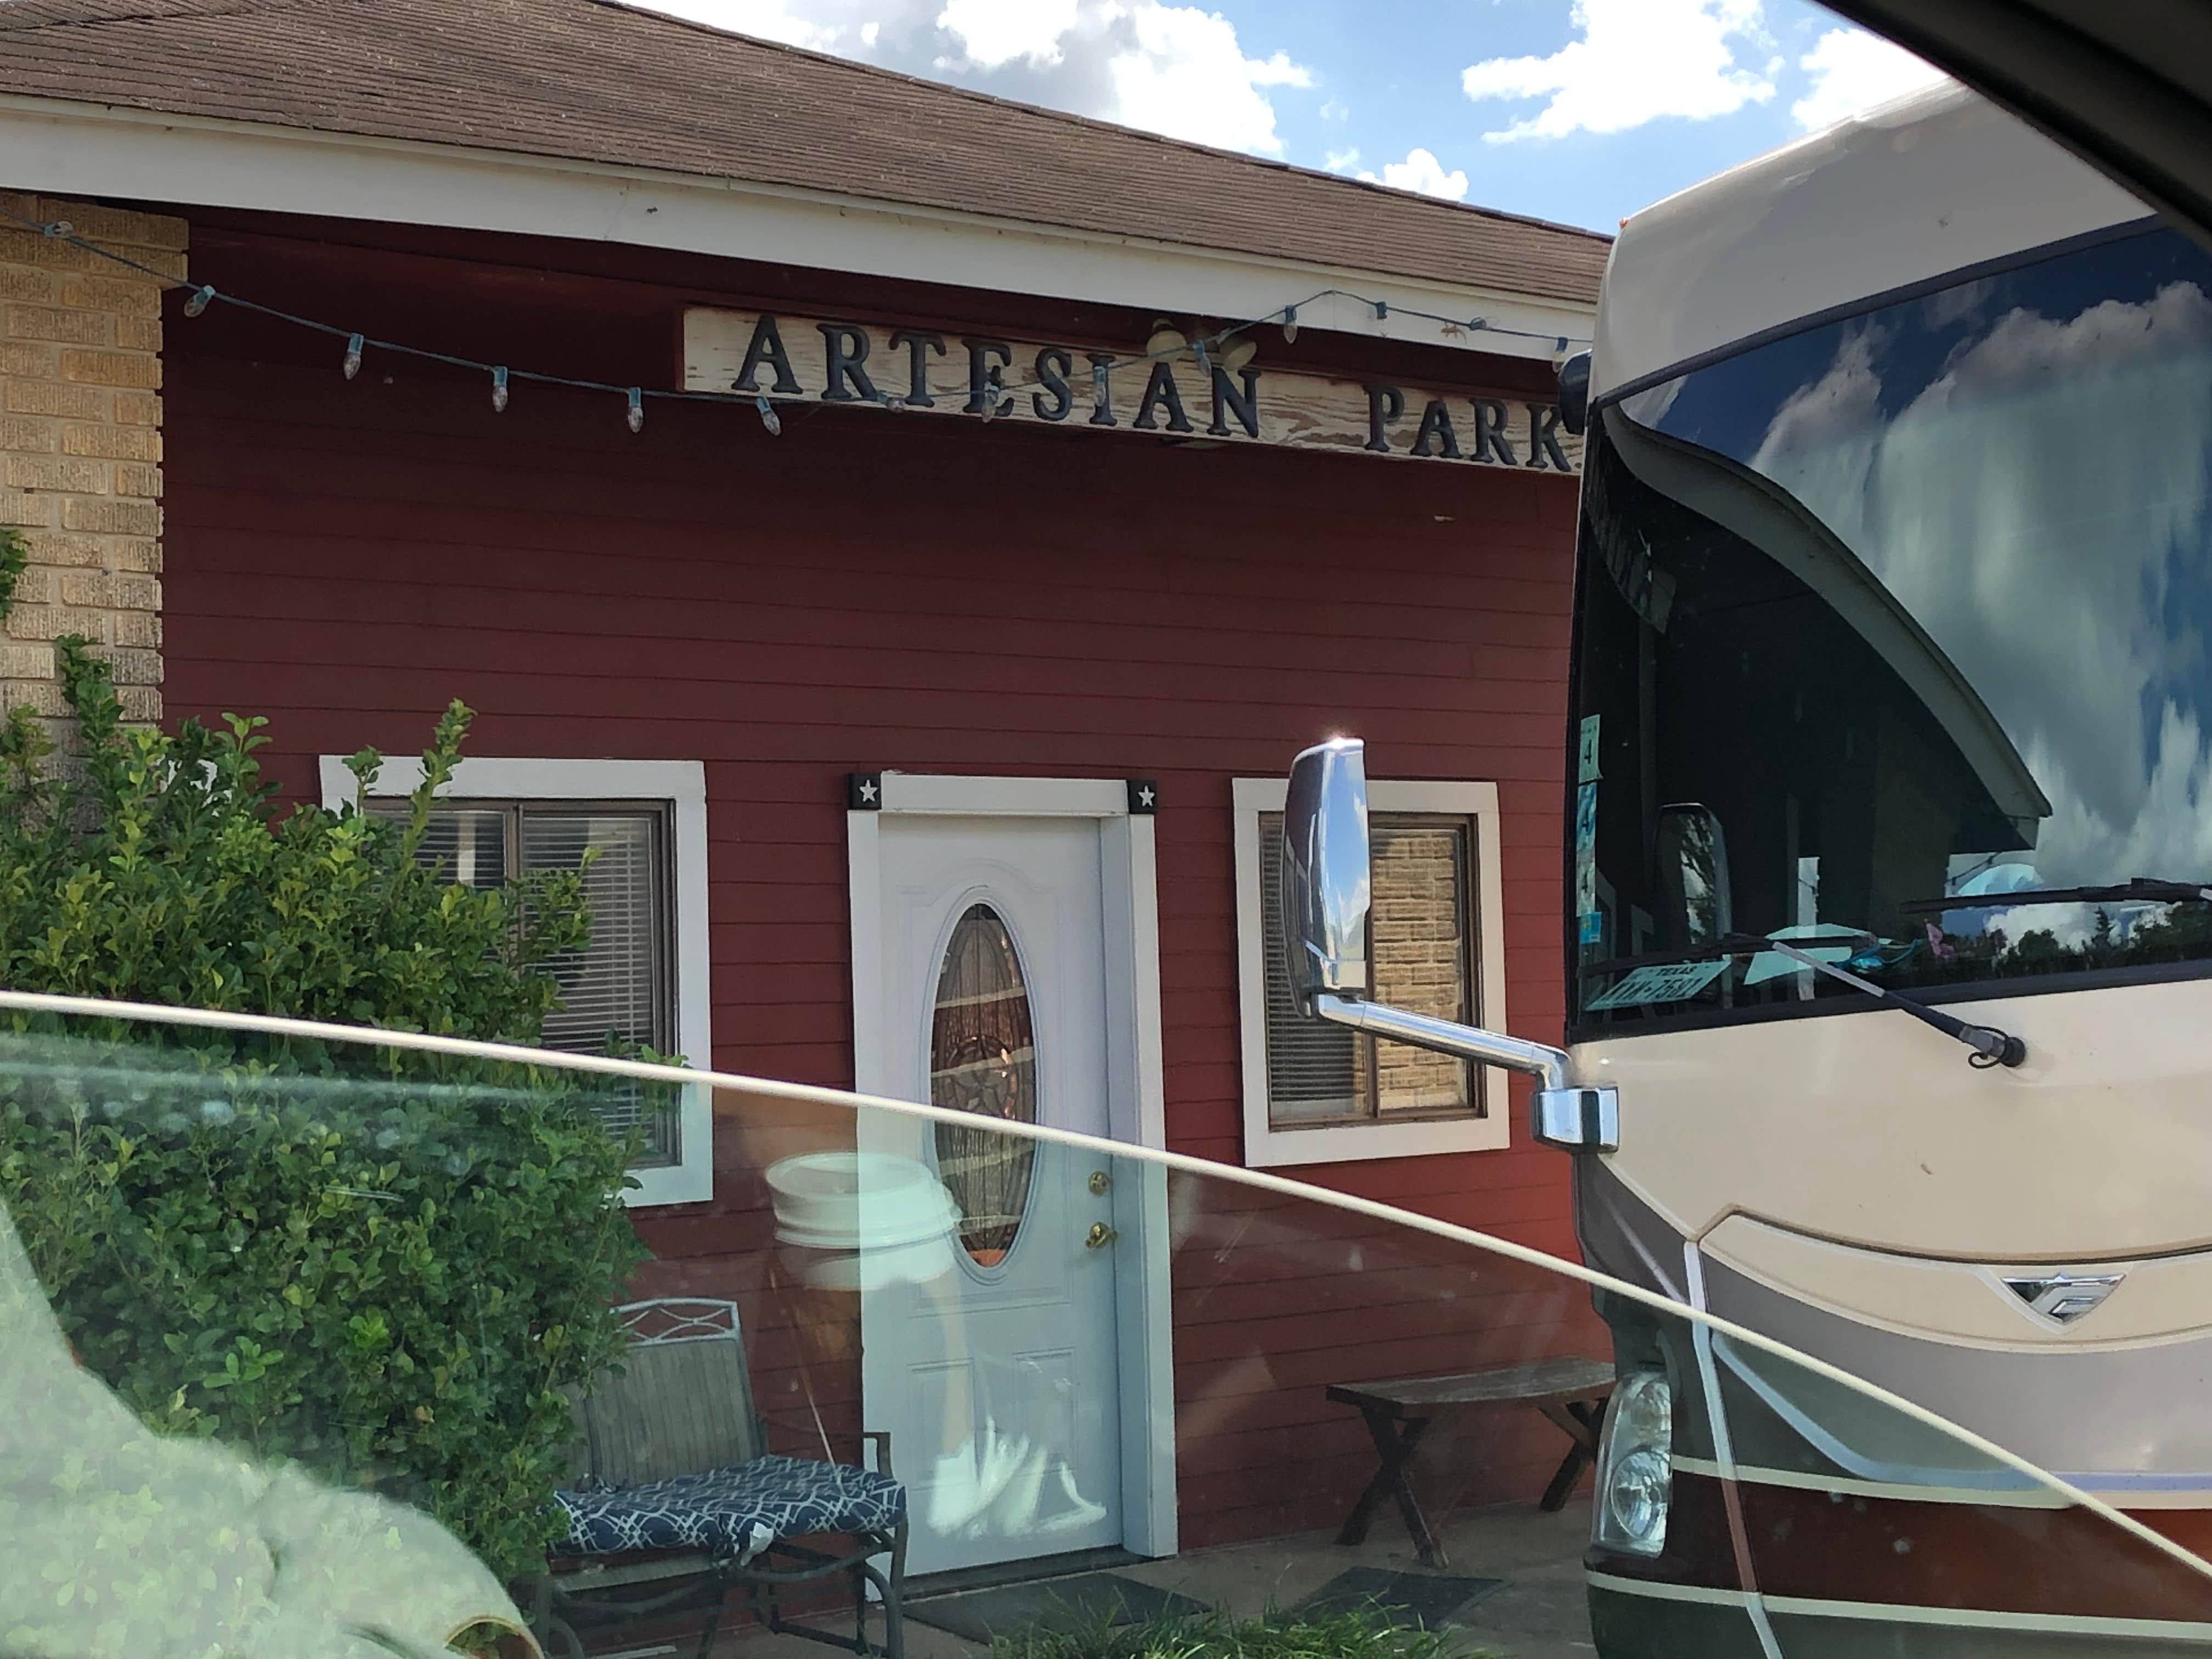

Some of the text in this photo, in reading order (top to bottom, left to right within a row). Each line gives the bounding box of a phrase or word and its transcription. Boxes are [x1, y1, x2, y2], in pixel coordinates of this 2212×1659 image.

[731, 314, 1572, 472] ARTESIAN PARK
[1584, 739, 1592, 764] 4
[1655, 966, 1697, 977] TEXAS
